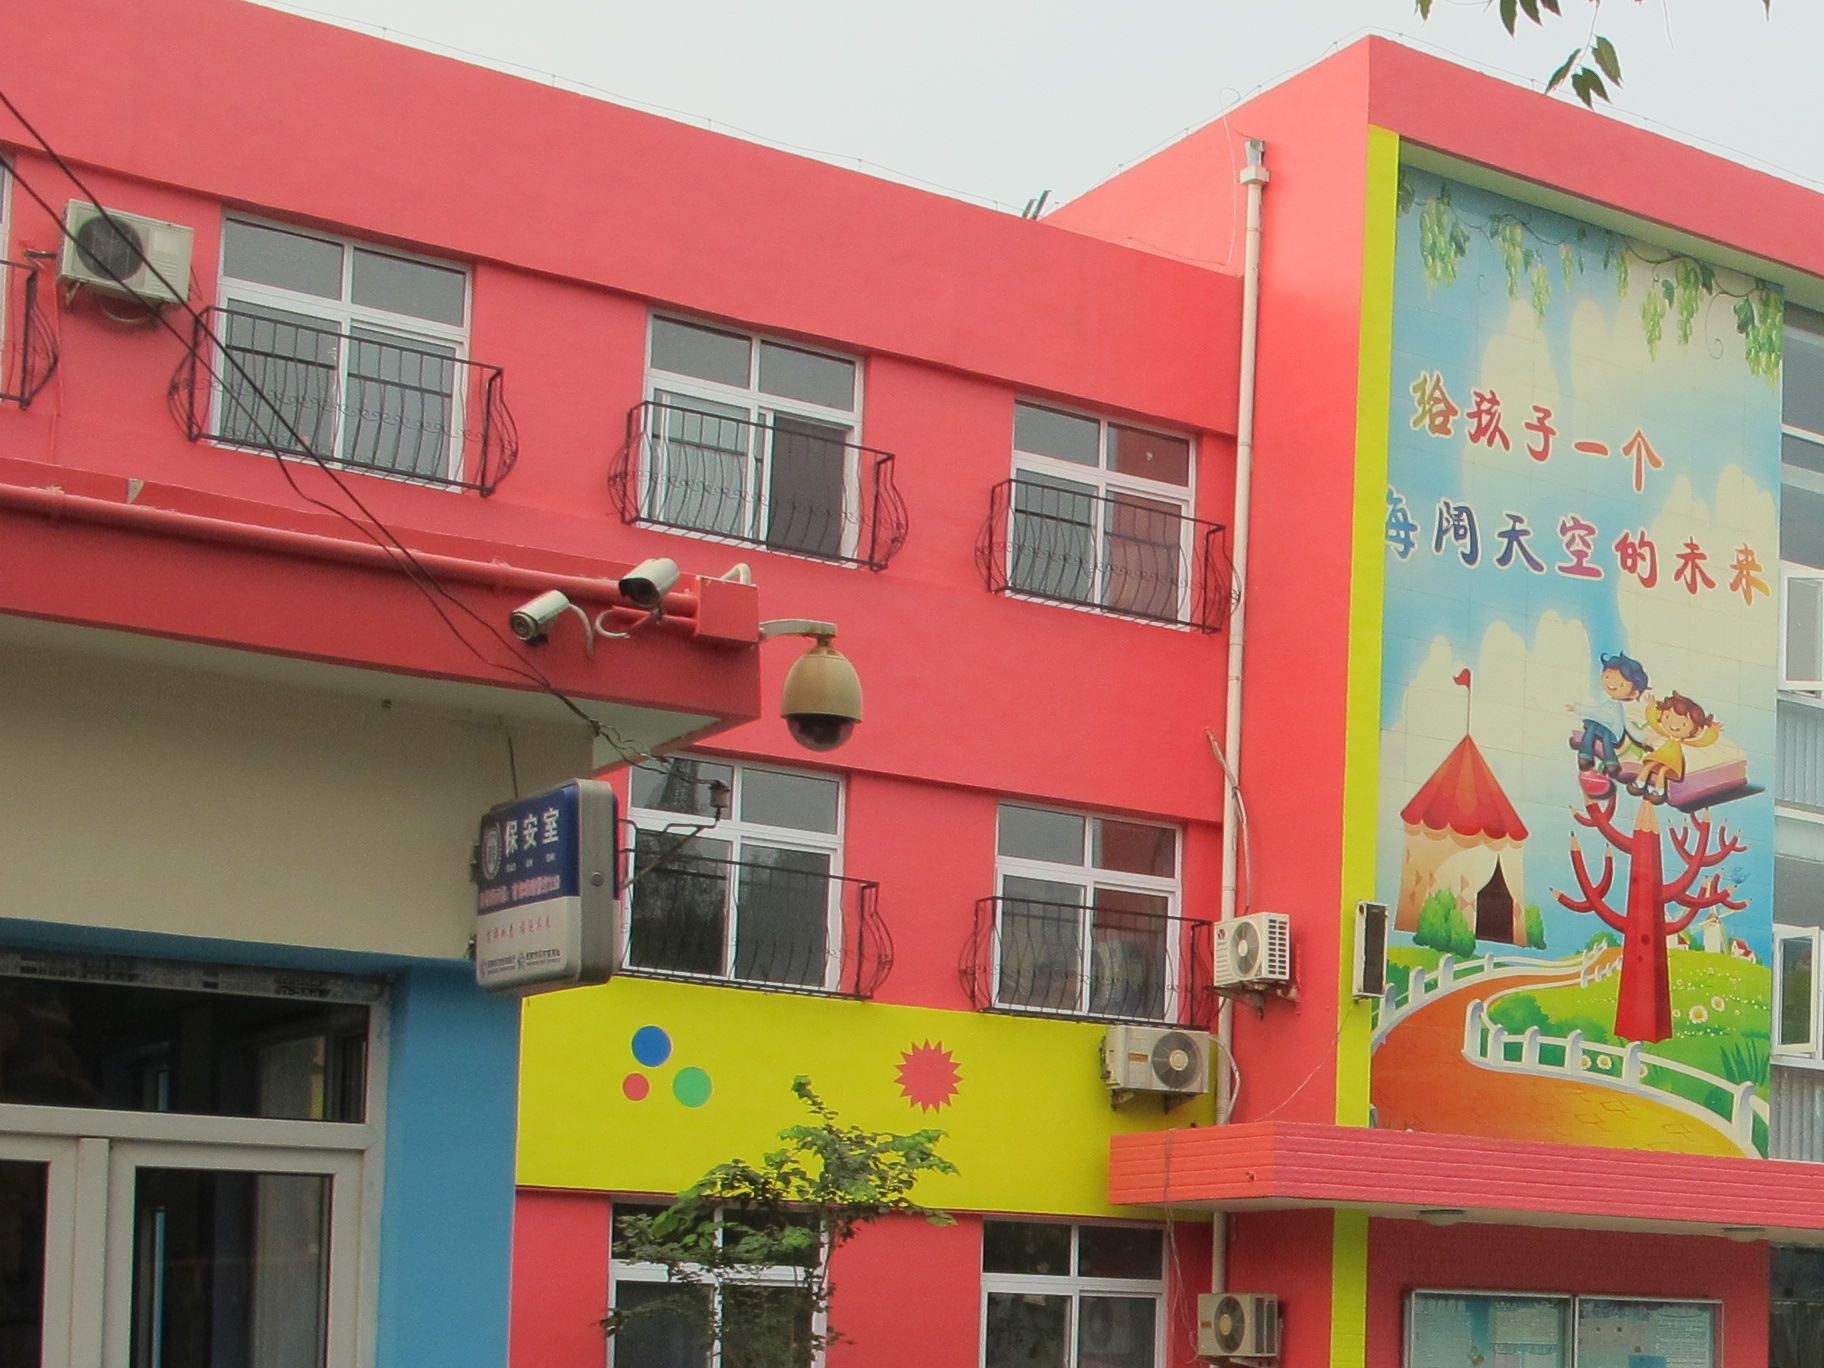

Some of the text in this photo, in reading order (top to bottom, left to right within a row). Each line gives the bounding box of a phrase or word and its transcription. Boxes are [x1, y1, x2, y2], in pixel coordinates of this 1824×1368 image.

[1409, 369, 1664, 493] 给孩子一个
[503, 807, 561, 858] 保安室
